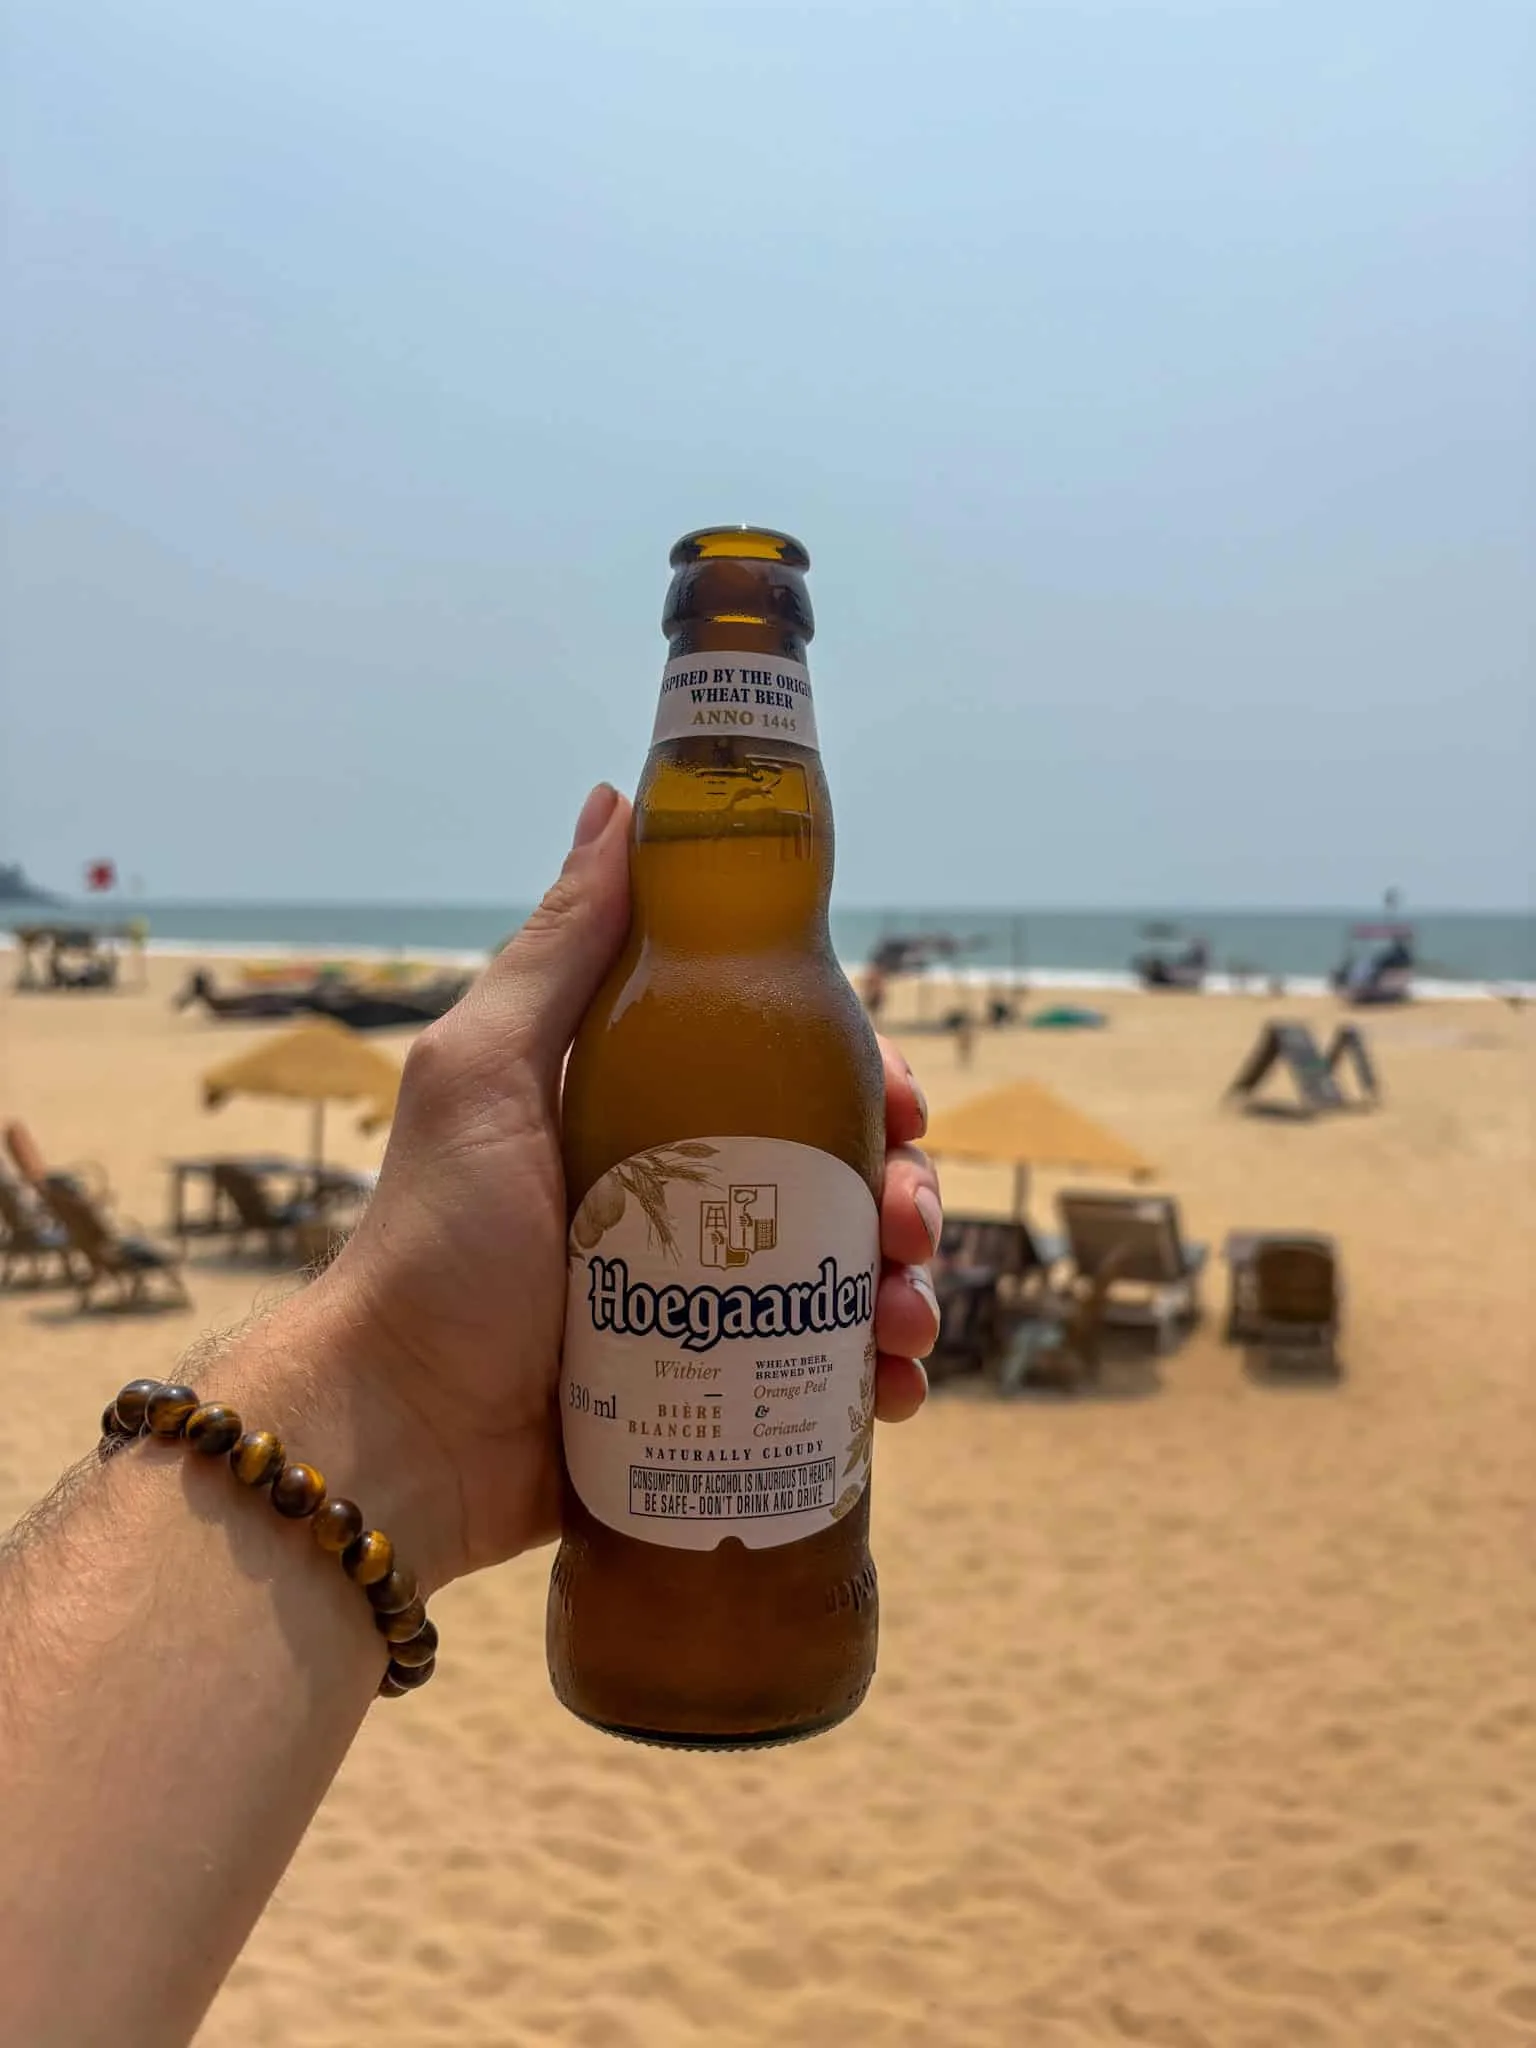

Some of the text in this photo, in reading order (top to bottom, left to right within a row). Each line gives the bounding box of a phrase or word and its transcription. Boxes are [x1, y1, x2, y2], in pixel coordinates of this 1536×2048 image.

[713, 669, 735, 683] BY
[740, 669, 772, 686] THE
[691, 688, 793, 709] WHEAT BEER
[692, 710, 796, 732] ANNO 1445
[588, 1255, 873, 1352] Hoegaarden
[655, 1359, 722, 1381] Witbier
[755, 1355, 826, 1368] WHEAT BEER
[755, 1364, 833, 1379] BREWED WITH
[753, 1377, 828, 1400] Orange Peel
[568, 1382, 617, 1420] 330 ml
[658, 1401, 722, 1419] BIÈRE
[755, 1405, 769, 1418] &
[628, 1420, 722, 1439] BLANCHE
[752, 1418, 818, 1438] Coriander
[644, 1439, 824, 1461] NATURALLY CLOUDY
[632, 1462, 833, 1494] CONSUMPTION OF ALCOHOL IS INJURIOUS TO HEALTH
[645, 1493, 657, 1512] BE
[699, 1495, 732, 1515] DON'T
[737, 1492, 770, 1514] DRINK
[773, 1491, 794, 1511] AND
[797, 1485, 822, 1507] DRIVE
